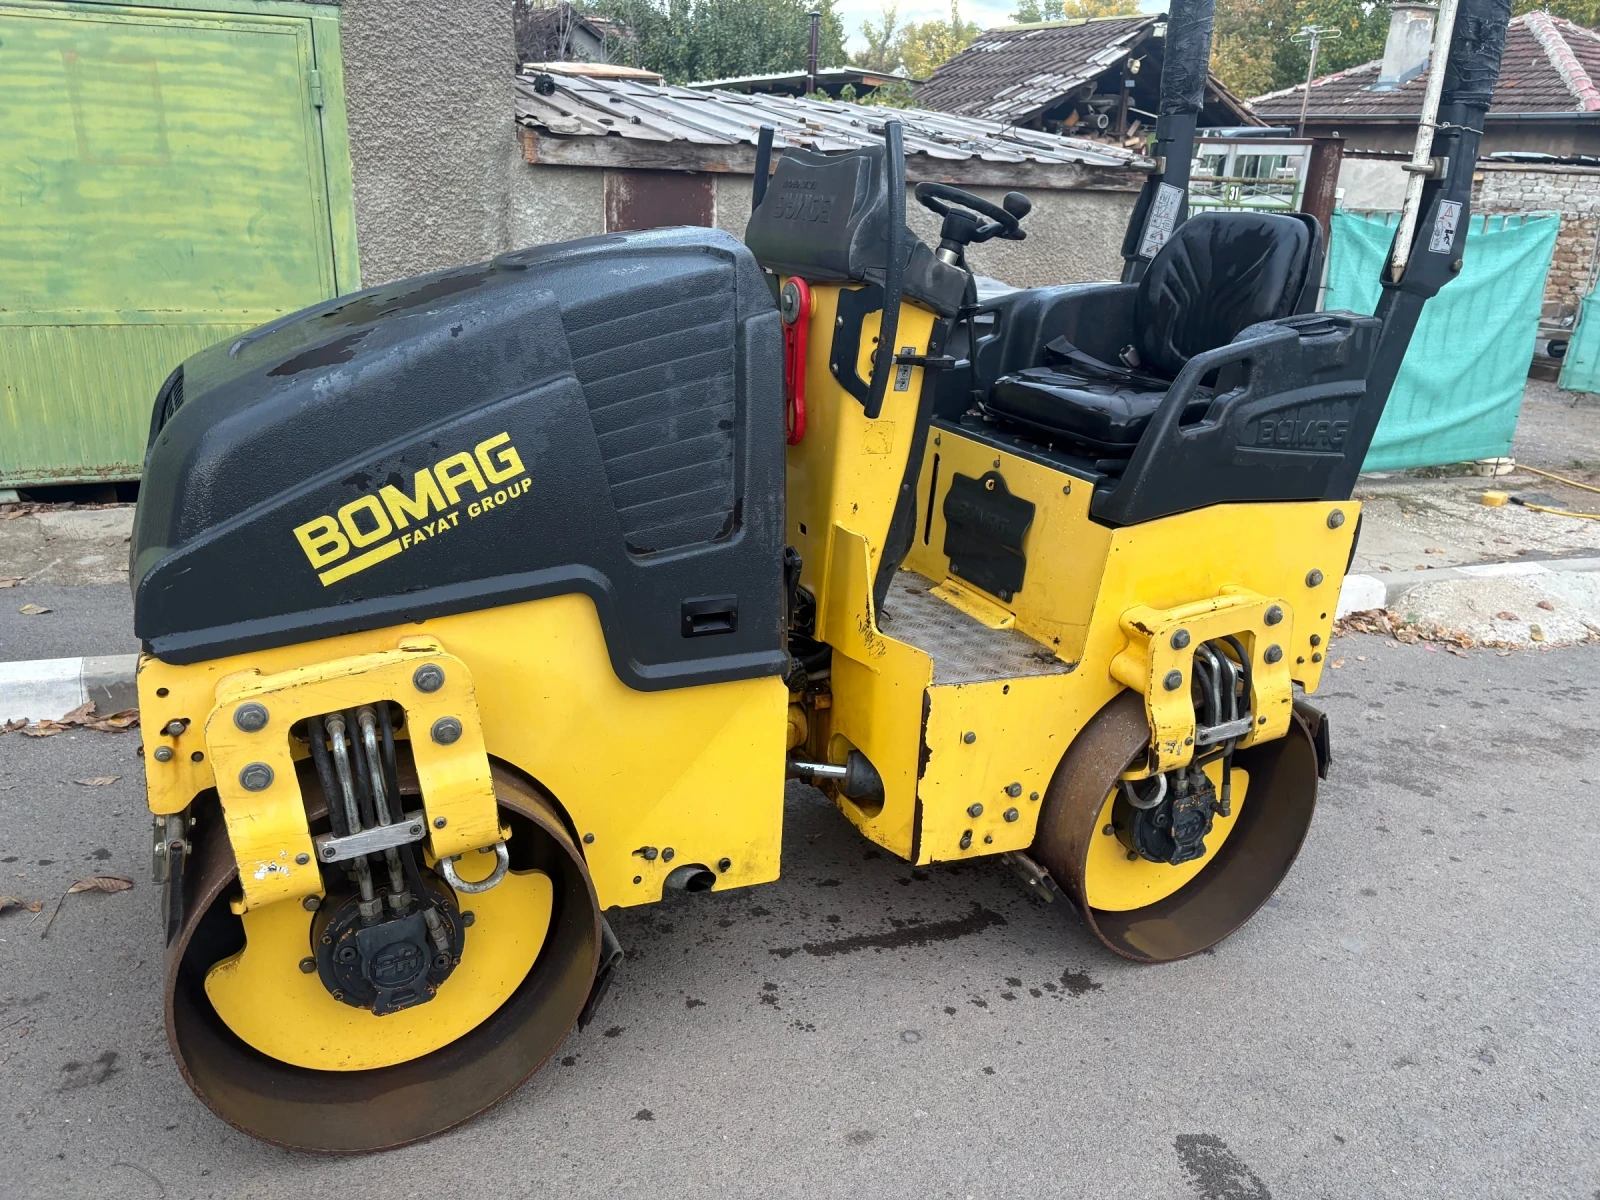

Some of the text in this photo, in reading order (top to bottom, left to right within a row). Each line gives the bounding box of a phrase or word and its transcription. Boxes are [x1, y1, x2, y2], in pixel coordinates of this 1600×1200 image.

[1229, 186, 1239, 201] 31
[1258, 420, 1349, 445] BOMAG
[293, 431, 526, 570] BOMAG
[401, 477, 533, 550] FAYAT GROUP
